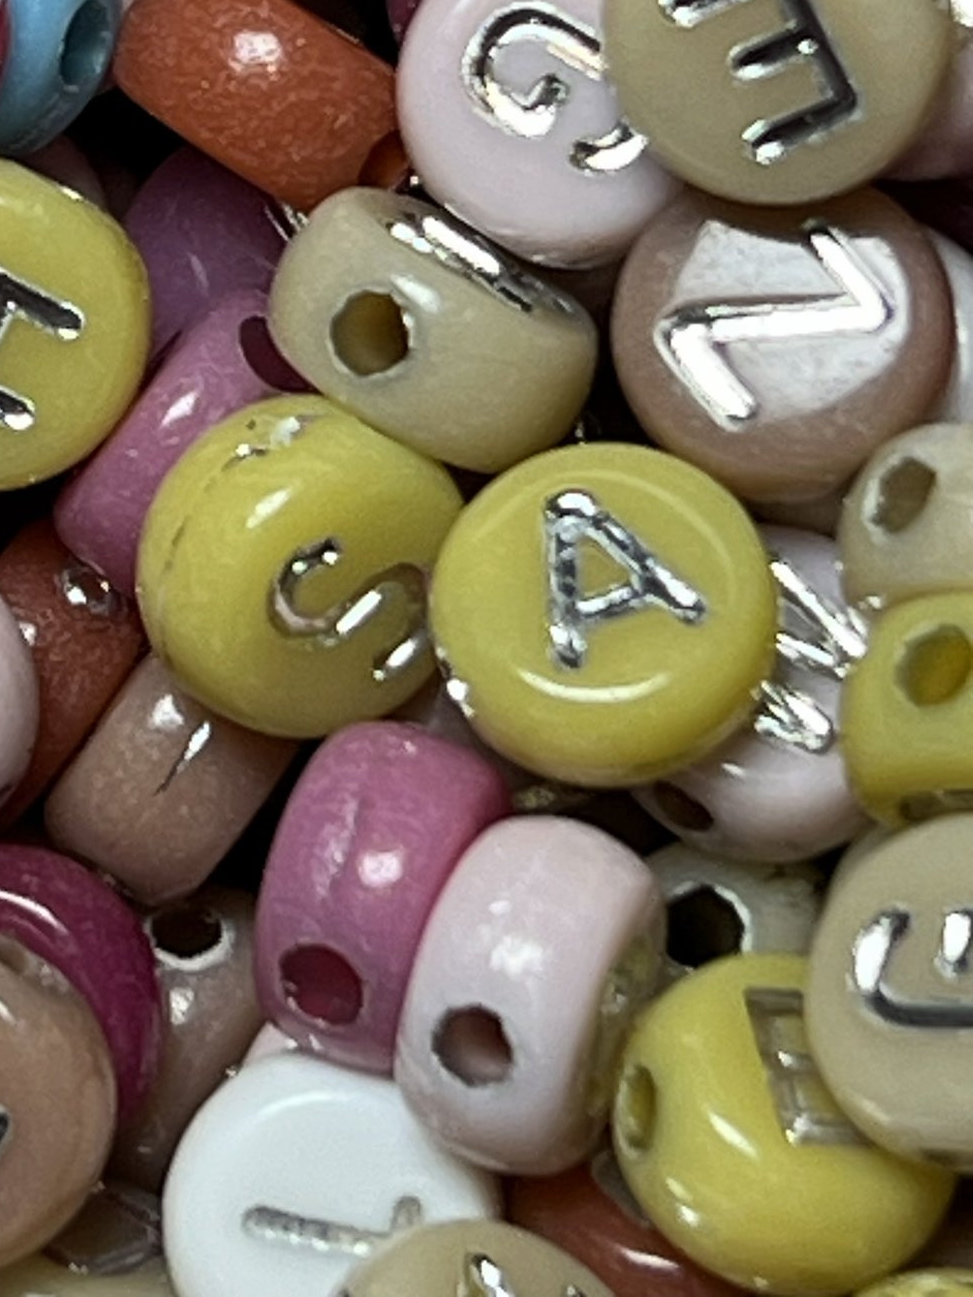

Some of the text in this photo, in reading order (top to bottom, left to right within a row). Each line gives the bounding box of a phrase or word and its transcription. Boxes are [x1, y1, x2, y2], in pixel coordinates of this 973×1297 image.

[652, 216, 897, 432] Z
[272, 537, 433, 682] S
[545, 487, 707, 669] A
